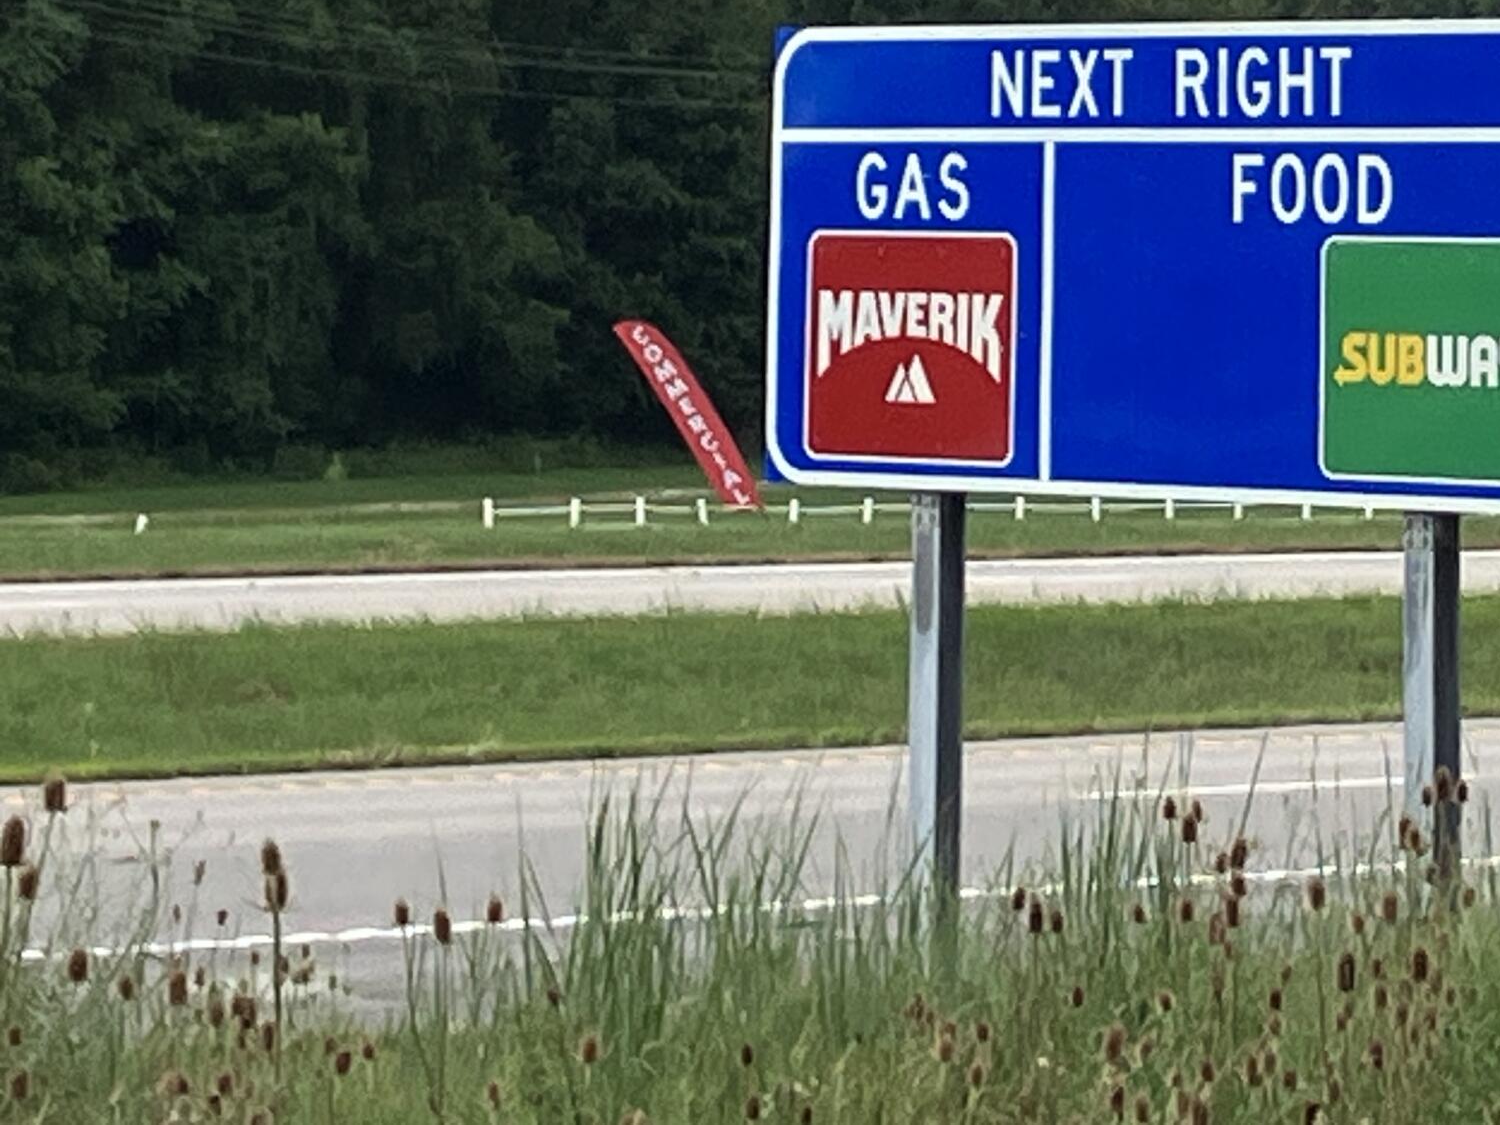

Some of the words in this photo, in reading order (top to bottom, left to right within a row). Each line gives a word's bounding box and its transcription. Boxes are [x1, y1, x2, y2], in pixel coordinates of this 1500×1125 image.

[991, 48, 1134, 118] NEXT
[1175, 47, 1352, 118] RIGHT
[856, 152, 969, 221] GAS
[1232, 153, 1393, 224] FOOD
[816, 289, 1004, 383] MAVERIK
[632, 324, 751, 506] COMMERCIAL
